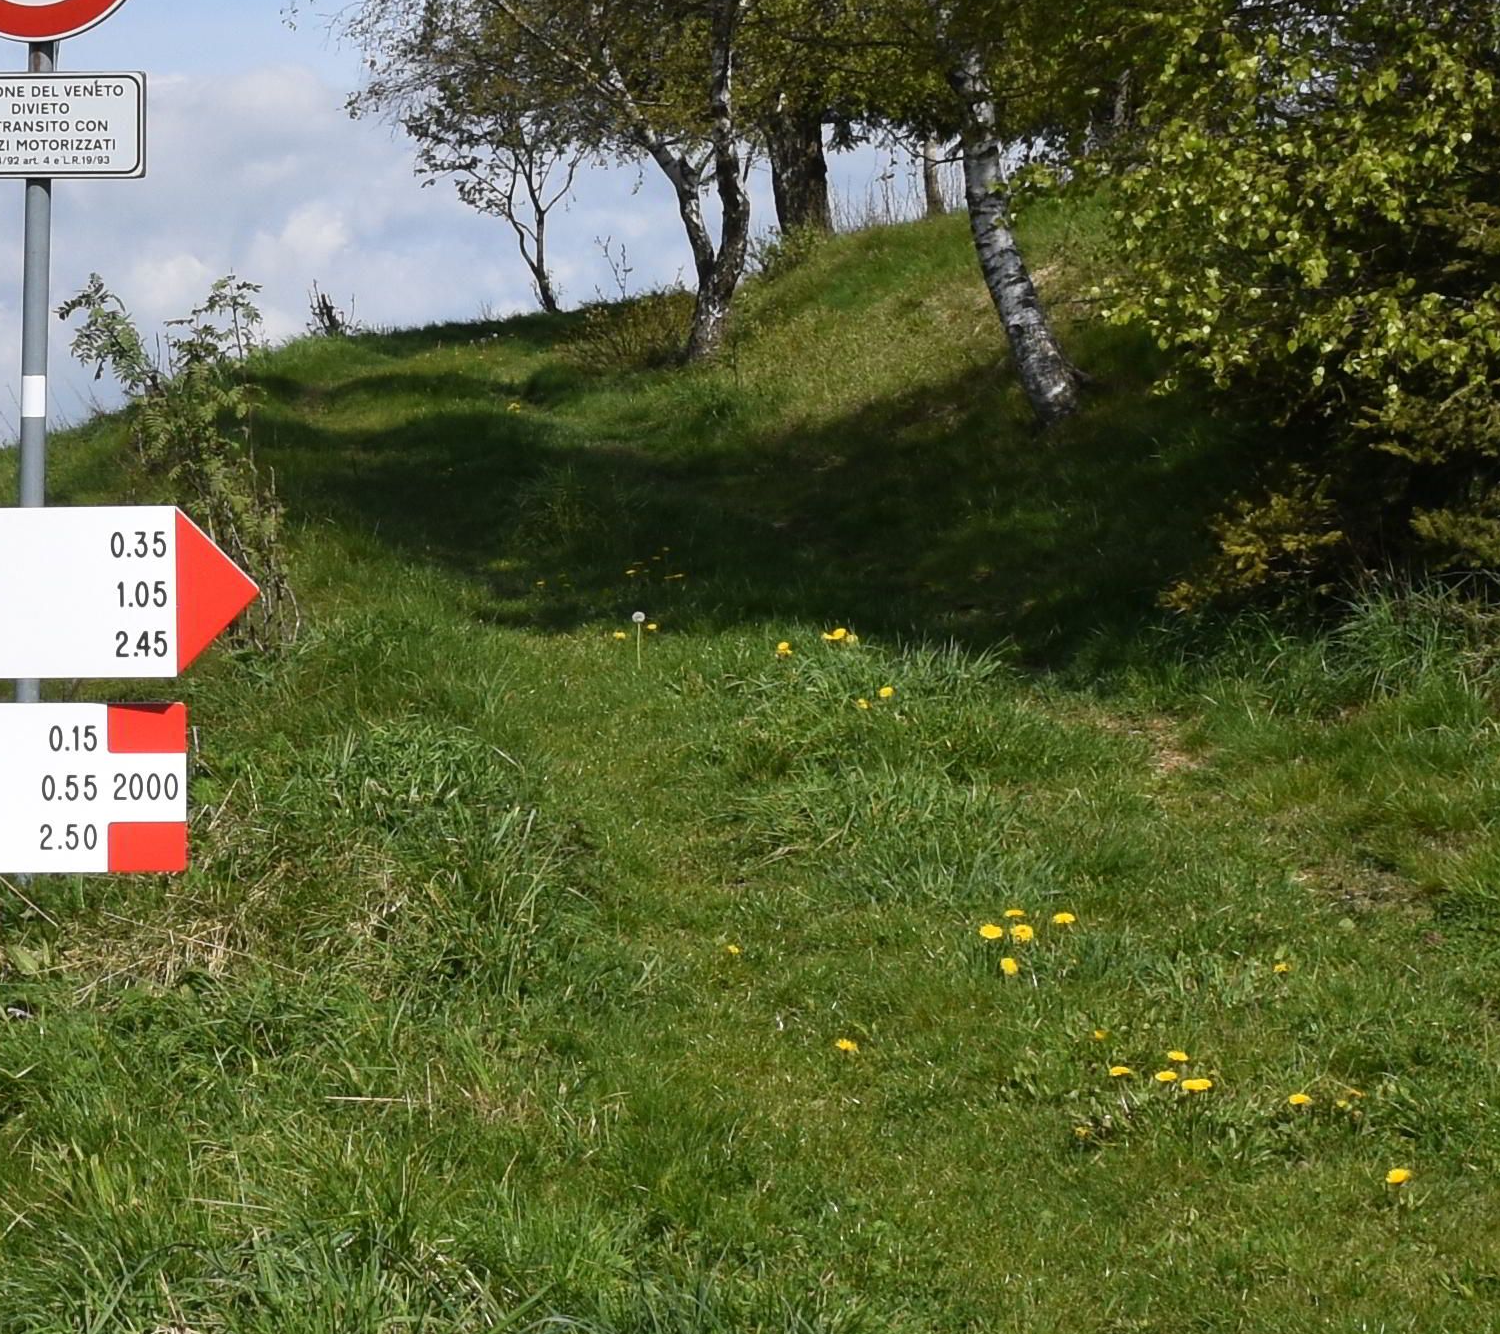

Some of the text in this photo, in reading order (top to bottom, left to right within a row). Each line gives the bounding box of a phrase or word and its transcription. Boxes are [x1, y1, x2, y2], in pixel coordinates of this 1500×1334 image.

[31, 85, 59, 97] DEL
[64, 84, 124, 97] VENETO
[11, 103, 70, 114] DIVIETO
[75, 120, 108, 132] CON
[16, 139, 116, 151] MOTORIZZATI
[111, 532, 166, 557] 0.35
[118, 581, 166, 607] 1.05
[116, 631, 167, 657] 2.45
[50, 726, 96, 751] 0.15
[42, 775, 96, 800] 0.55
[114, 774, 178, 800] 2000
[41, 824, 96, 849] 2.50
